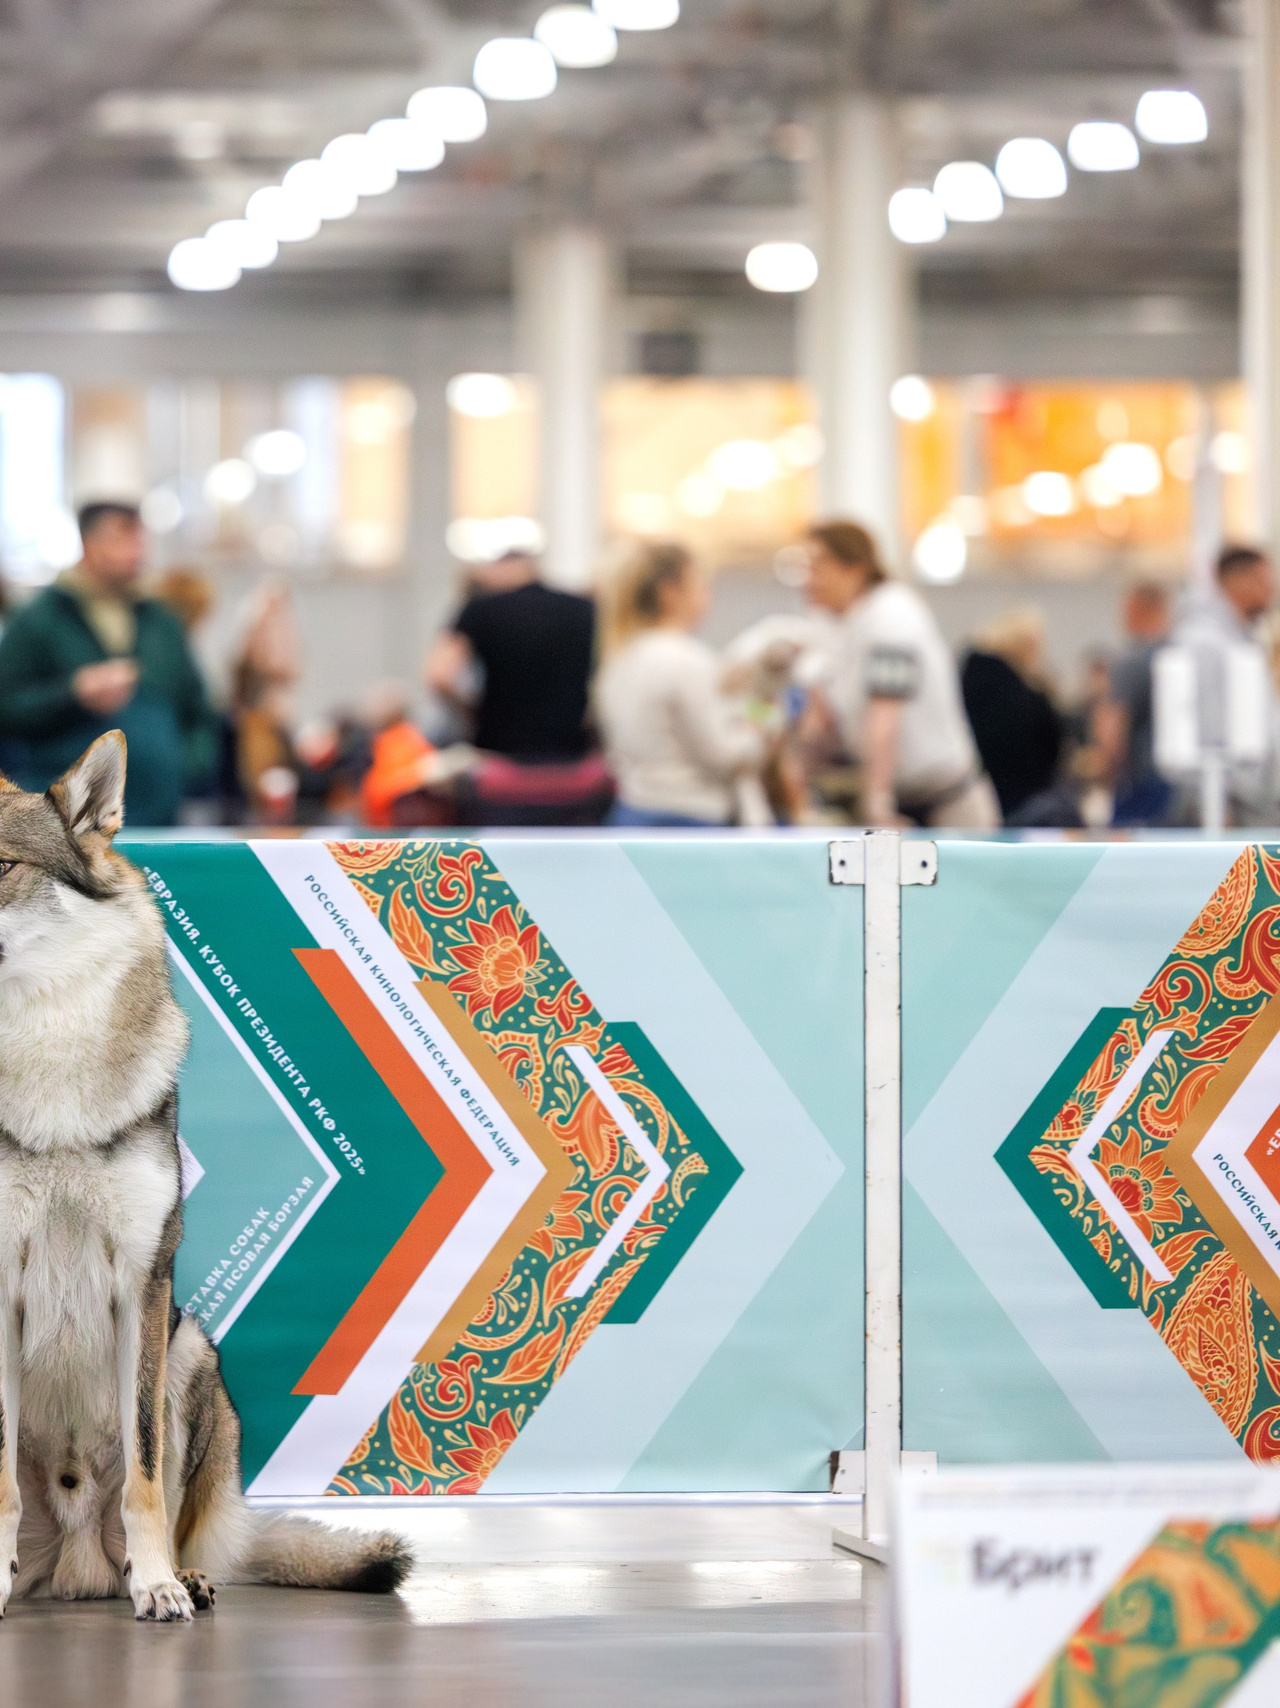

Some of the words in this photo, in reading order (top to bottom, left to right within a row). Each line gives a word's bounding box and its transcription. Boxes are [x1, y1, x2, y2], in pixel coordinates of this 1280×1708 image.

[199, 945, 242, 1007] КУБОК
[236, 997, 311, 1098] ПРЕЗИДЕНТА
[308, 1098, 336, 1131] РКФ
[333, 1132, 366, 1175] 2025»
[304, 874, 372, 964] РОССИЙСКАЯ
[370, 964, 462, 1087] КИНОЛОГИЧЕСКАЯ
[459, 1088, 520, 1167] ФЕДЕРАЦИЯ
[181, 1259, 233, 1317] СТАВКА
[229, 1206, 270, 1256] СОБАК
[198, 1290, 227, 1323] КАЯ
[223, 1232, 272, 1291] ПСОВАЯ
[267, 1176, 315, 1233] БОРЗАЯ
[1213, 1153, 1278, 1240] РОССИЙСКАЯ
